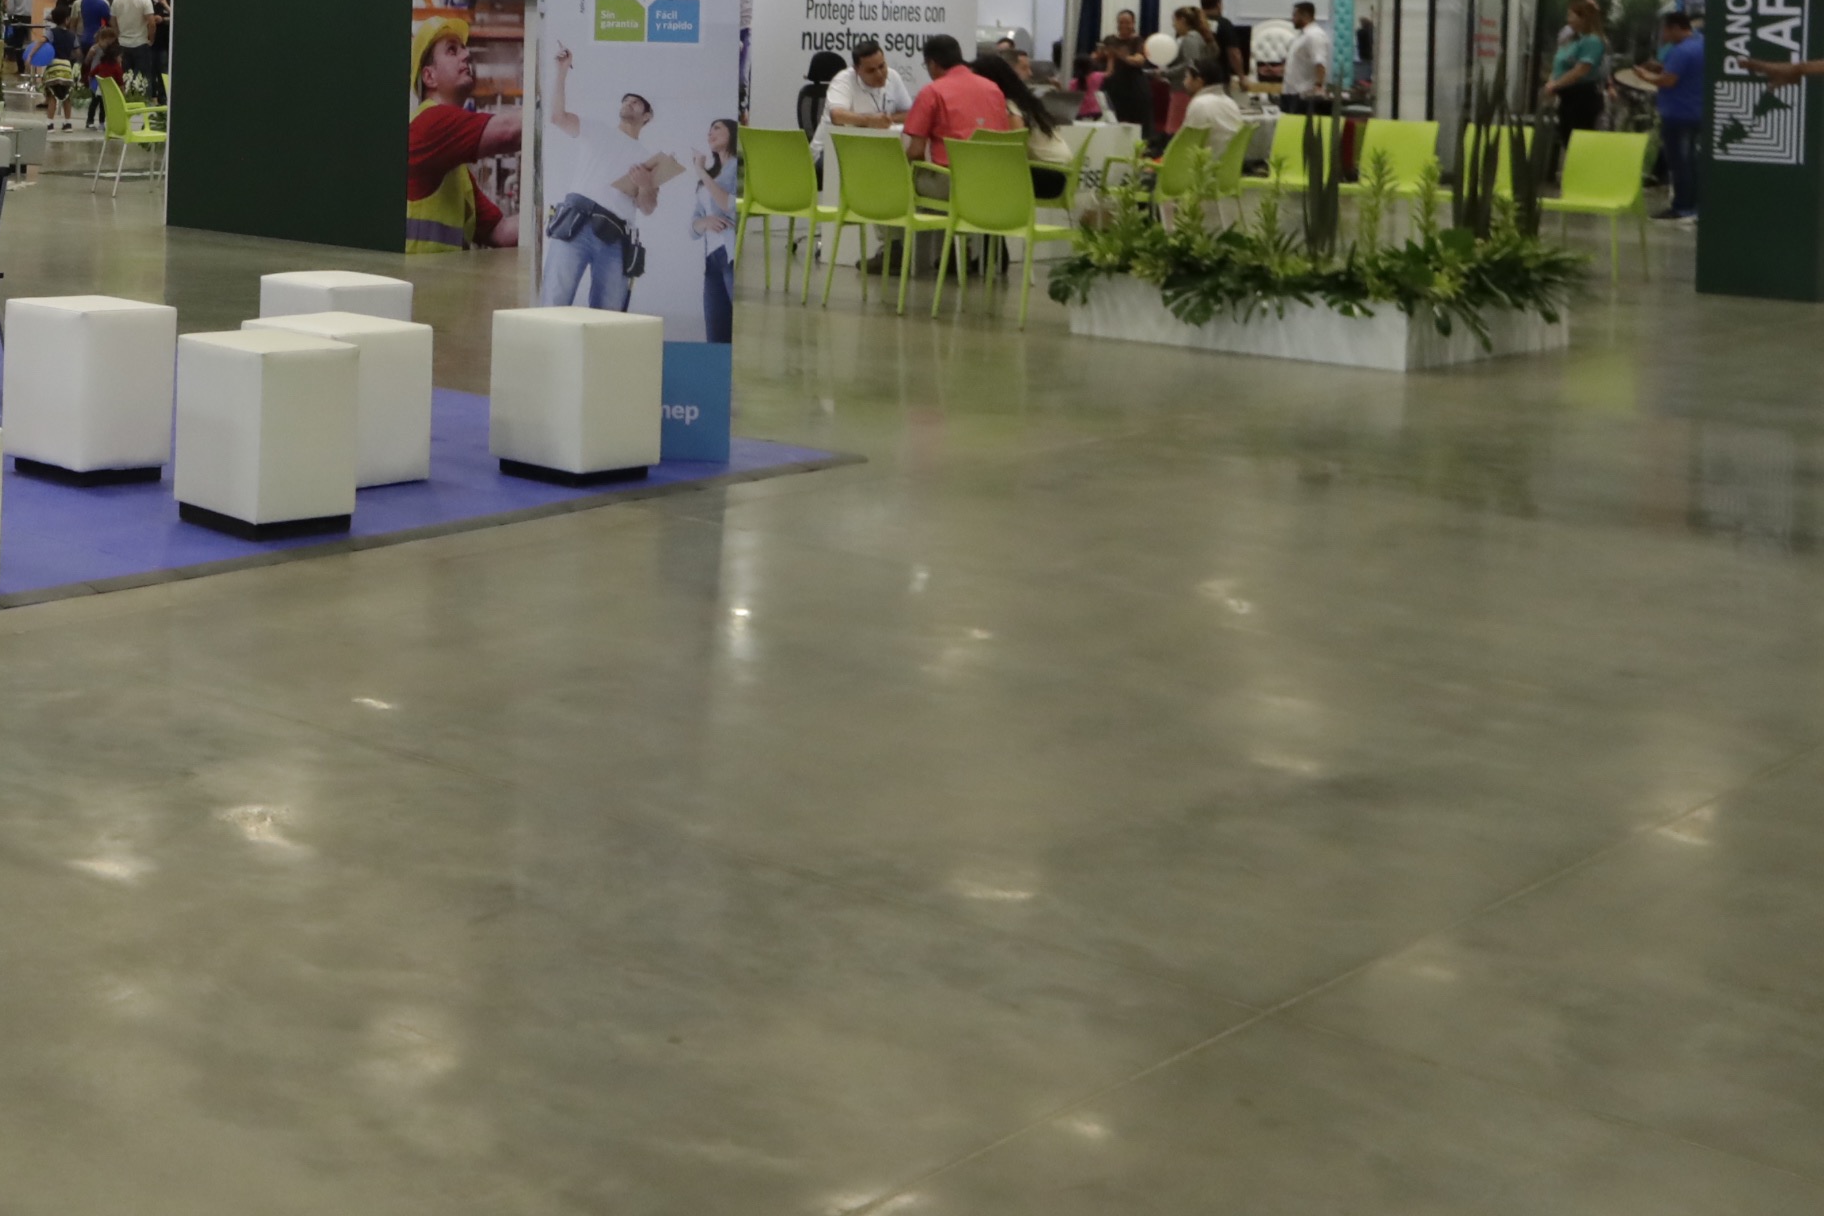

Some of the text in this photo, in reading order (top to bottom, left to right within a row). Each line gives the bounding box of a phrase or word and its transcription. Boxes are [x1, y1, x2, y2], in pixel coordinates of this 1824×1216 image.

[601, 10, 615, 19] Sin
[656, 10, 678, 20] Fácil
[859, 0, 878, 21] tus
[882, 0, 921, 22] bienes
[925, 6, 945, 23] con
[656, 23, 661, 31] y
[884, 33, 930, 58] segu
